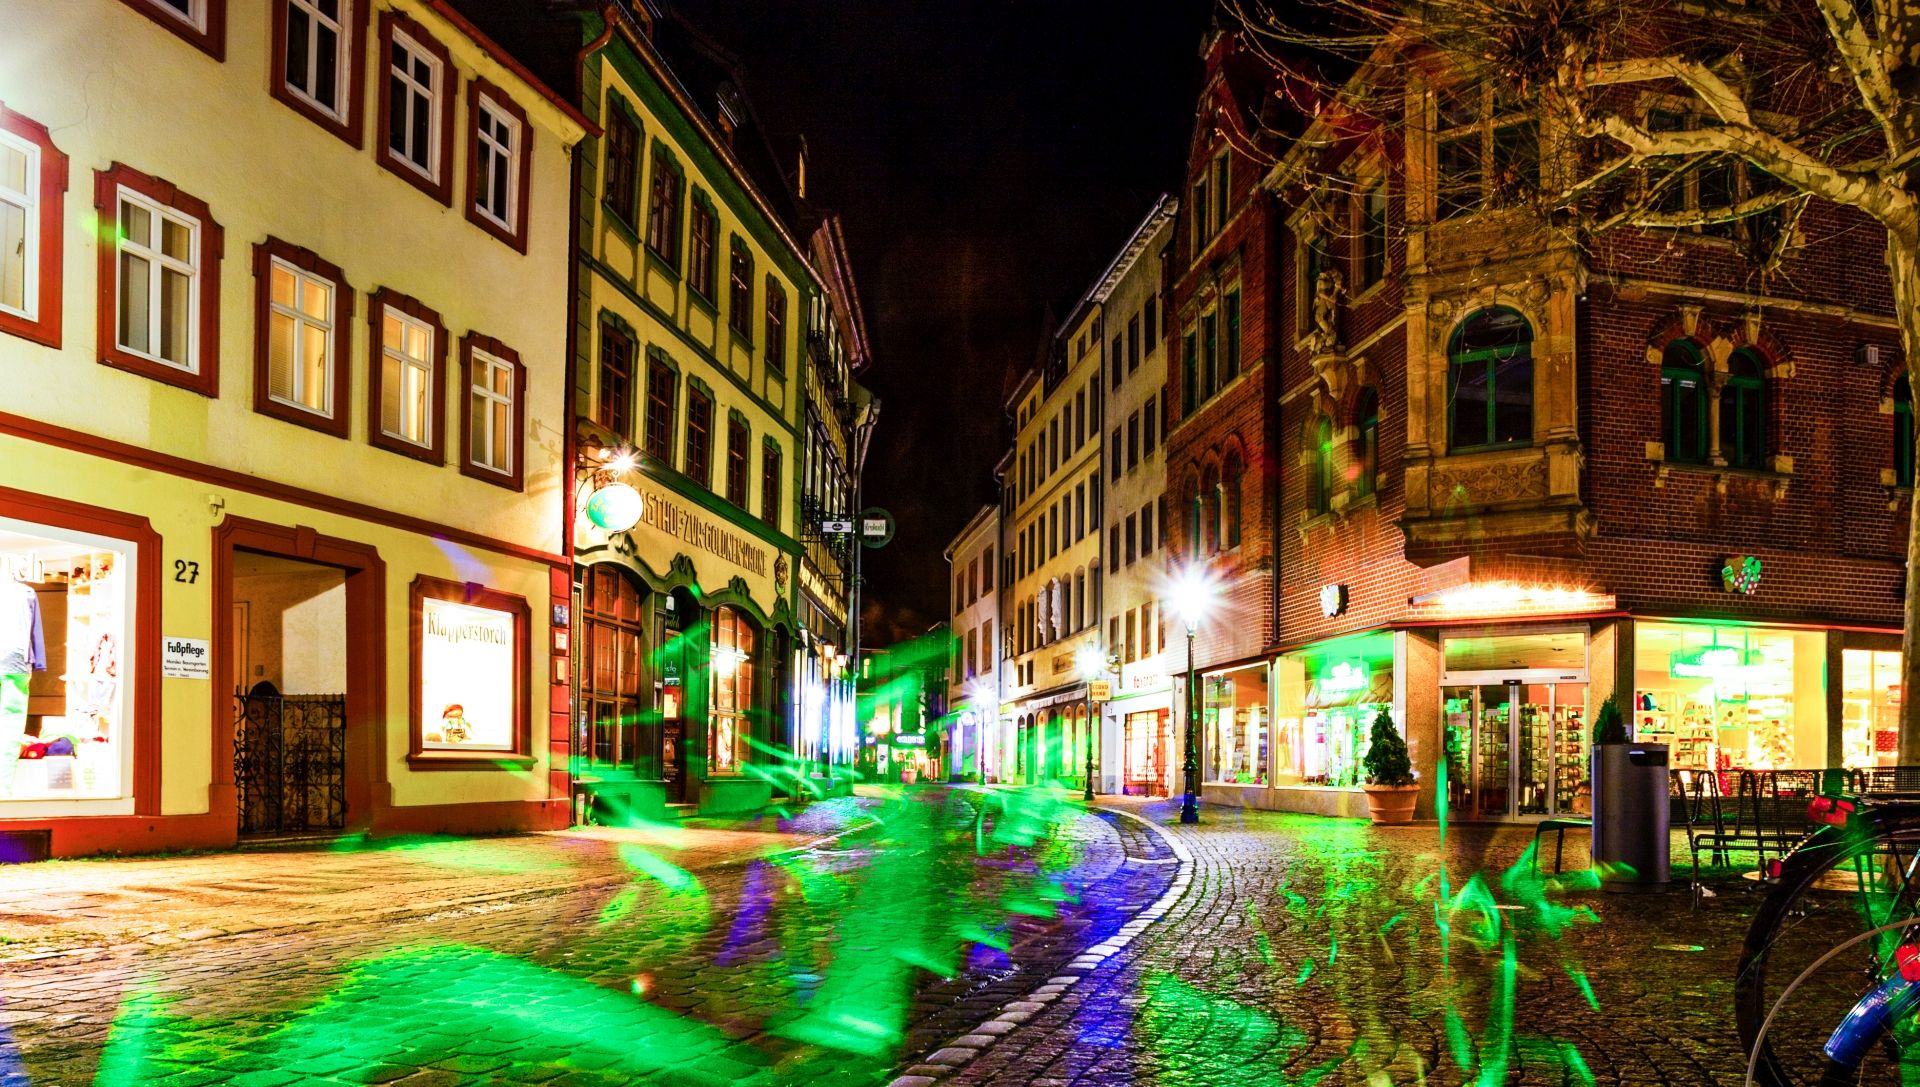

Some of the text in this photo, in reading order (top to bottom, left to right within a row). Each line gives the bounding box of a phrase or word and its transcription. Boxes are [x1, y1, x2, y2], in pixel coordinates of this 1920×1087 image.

[174, 559, 200, 584] 27
[428, 612, 506, 646] Klapperstorch
[167, 641, 205, 658] Fußpflege
